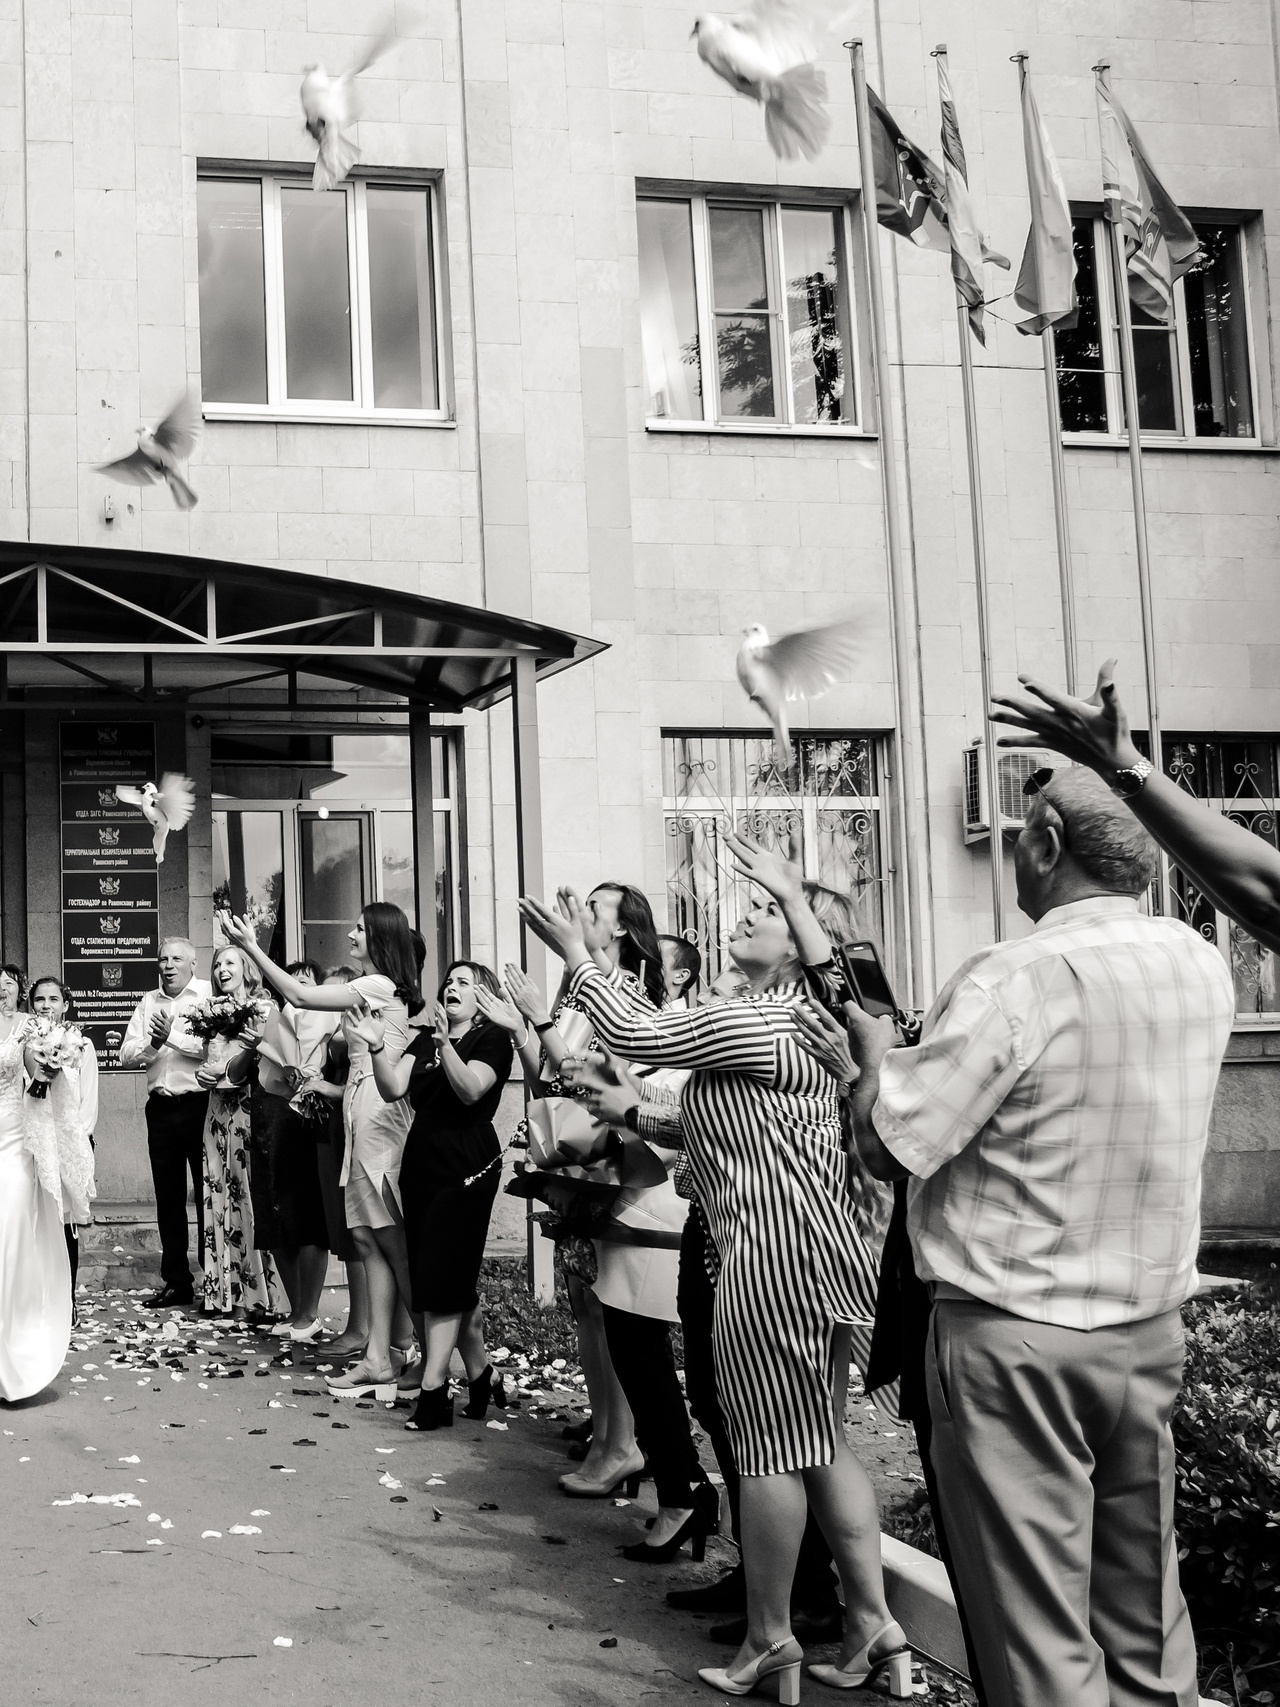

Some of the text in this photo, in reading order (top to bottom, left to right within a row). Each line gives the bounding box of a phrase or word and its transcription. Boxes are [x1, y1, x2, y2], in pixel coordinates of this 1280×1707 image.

[75, 810, 89, 818] ОТДЕЛ
[127, 810, 143, 818] района
[64, 848, 100, 856] ТЕРРИТОРИАЛЬНАЯ
[92, 858, 129, 866] Рамонского района
[68, 899, 101, 907] ГОСТЕХНАДЗОР
[108, 899, 134, 907] Рамонскому
[136, 899, 152, 908] району
[70, 936, 151, 945] ОТДЕЛ СТАТИСТИКИ ПРЕДПРИЯТИЙ
[70, 990, 87, 998] ИЛИАЛ
[73, 1000, 101, 1008] Воронежского
[101, 1001, 131, 1009] регионального
[77, 1010, 90, 1018] фонда
